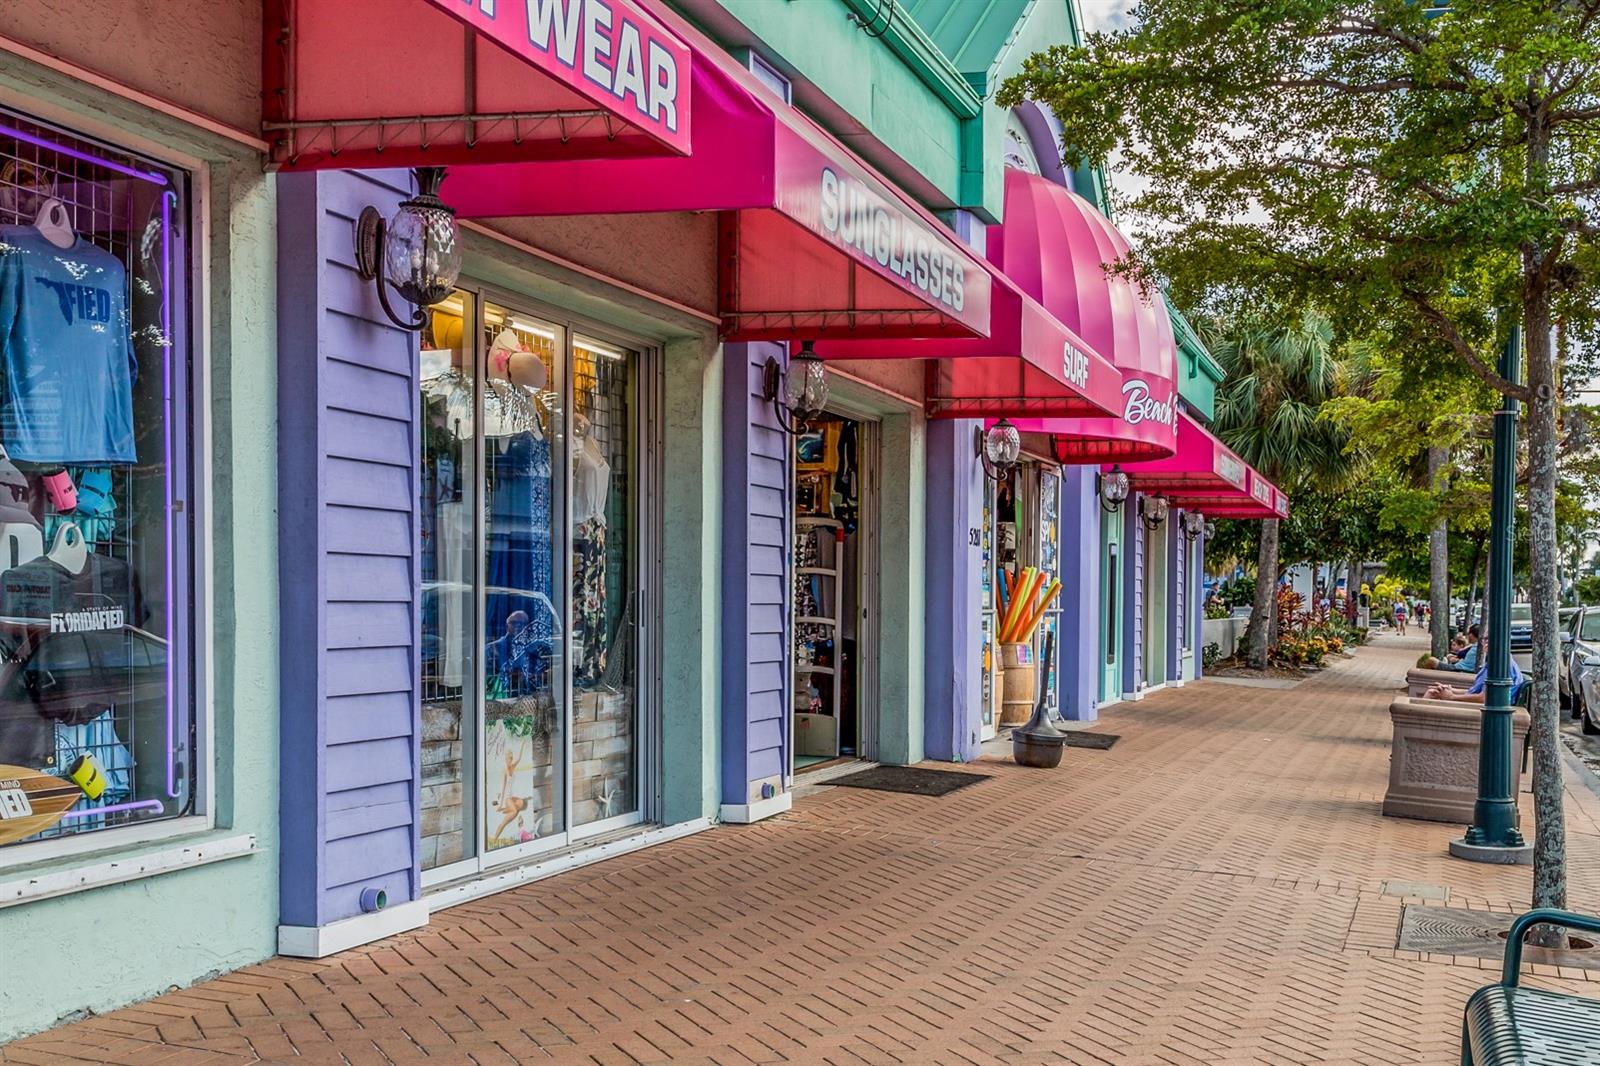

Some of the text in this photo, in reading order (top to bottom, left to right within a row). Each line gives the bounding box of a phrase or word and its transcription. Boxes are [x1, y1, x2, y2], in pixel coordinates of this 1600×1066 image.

[526, 0, 678, 133] WEAR
[820, 167, 964, 313] SUNGLASSES
[1063, 341, 1089, 389] SURF
[1122, 379, 1173, 425] Beach
